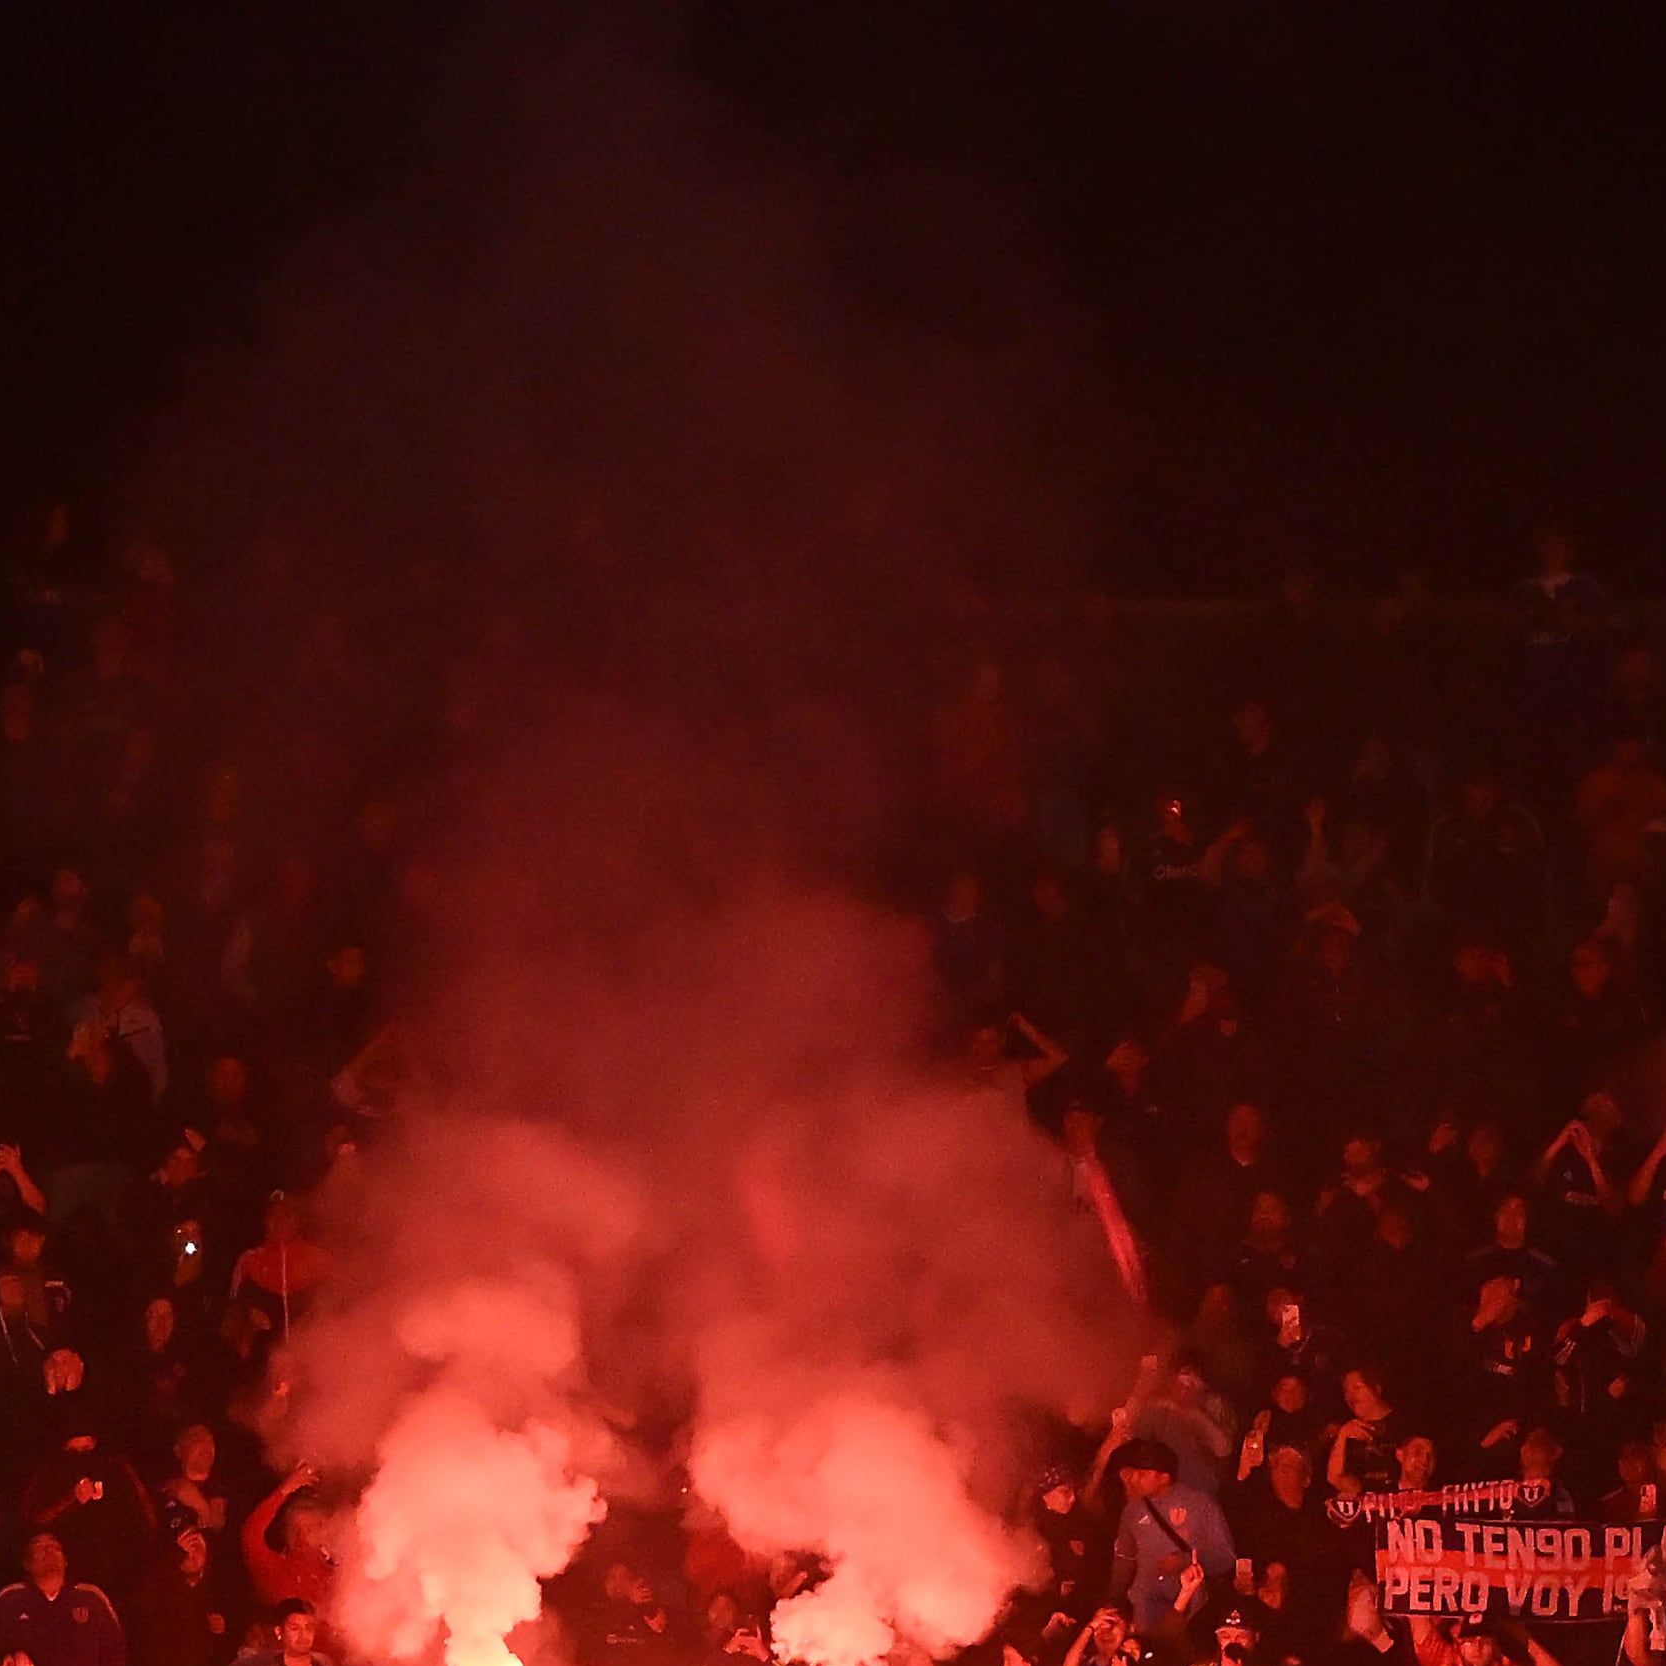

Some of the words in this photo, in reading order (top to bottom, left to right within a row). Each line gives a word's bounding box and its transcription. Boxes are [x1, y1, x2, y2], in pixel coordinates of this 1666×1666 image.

[1387, 1519, 1442, 1565] NO
[1384, 1567, 1490, 1614] PERO
[1505, 1573, 1588, 1617] VOY
